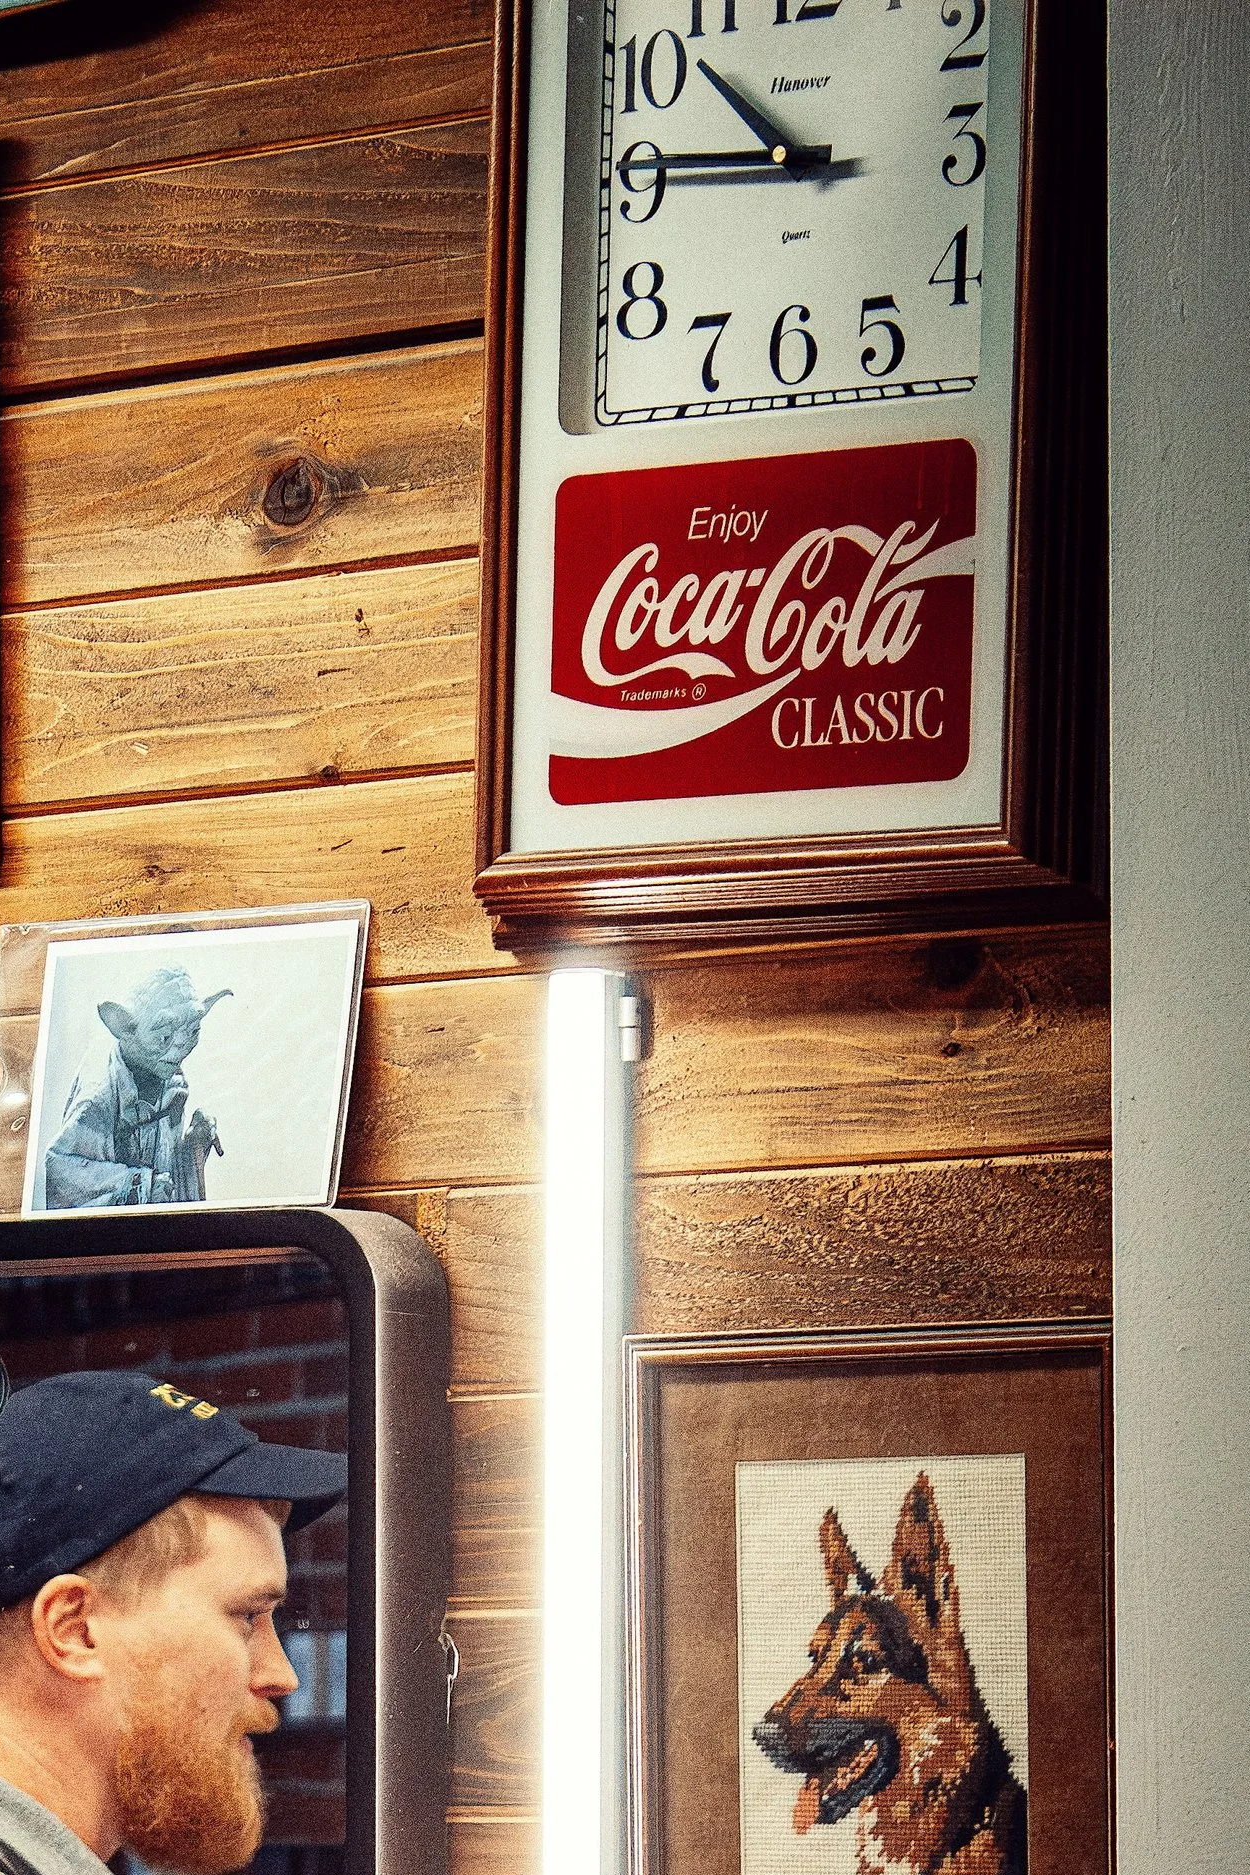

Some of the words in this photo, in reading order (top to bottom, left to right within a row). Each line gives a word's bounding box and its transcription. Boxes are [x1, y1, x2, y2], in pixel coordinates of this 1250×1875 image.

[619, 29, 687, 114] 10
[770, 75, 832, 94] Hanover
[618, 141, 667, 223] 9
[942, 102, 987, 187] 3
[781, 230, 811, 243] Quartz
[928, 224, 982, 306] 4
[616, 262, 668, 340] 8
[859, 294, 905, 376] 5
[687, 312, 733, 393] 7
[770, 305, 818, 385] 6
[687, 504, 769, 544] Enjoy
[581, 518, 942, 688] Coca-Cola
[620, 686, 687, 702] Trademarks
[771, 686, 944, 750] CLASSIC
